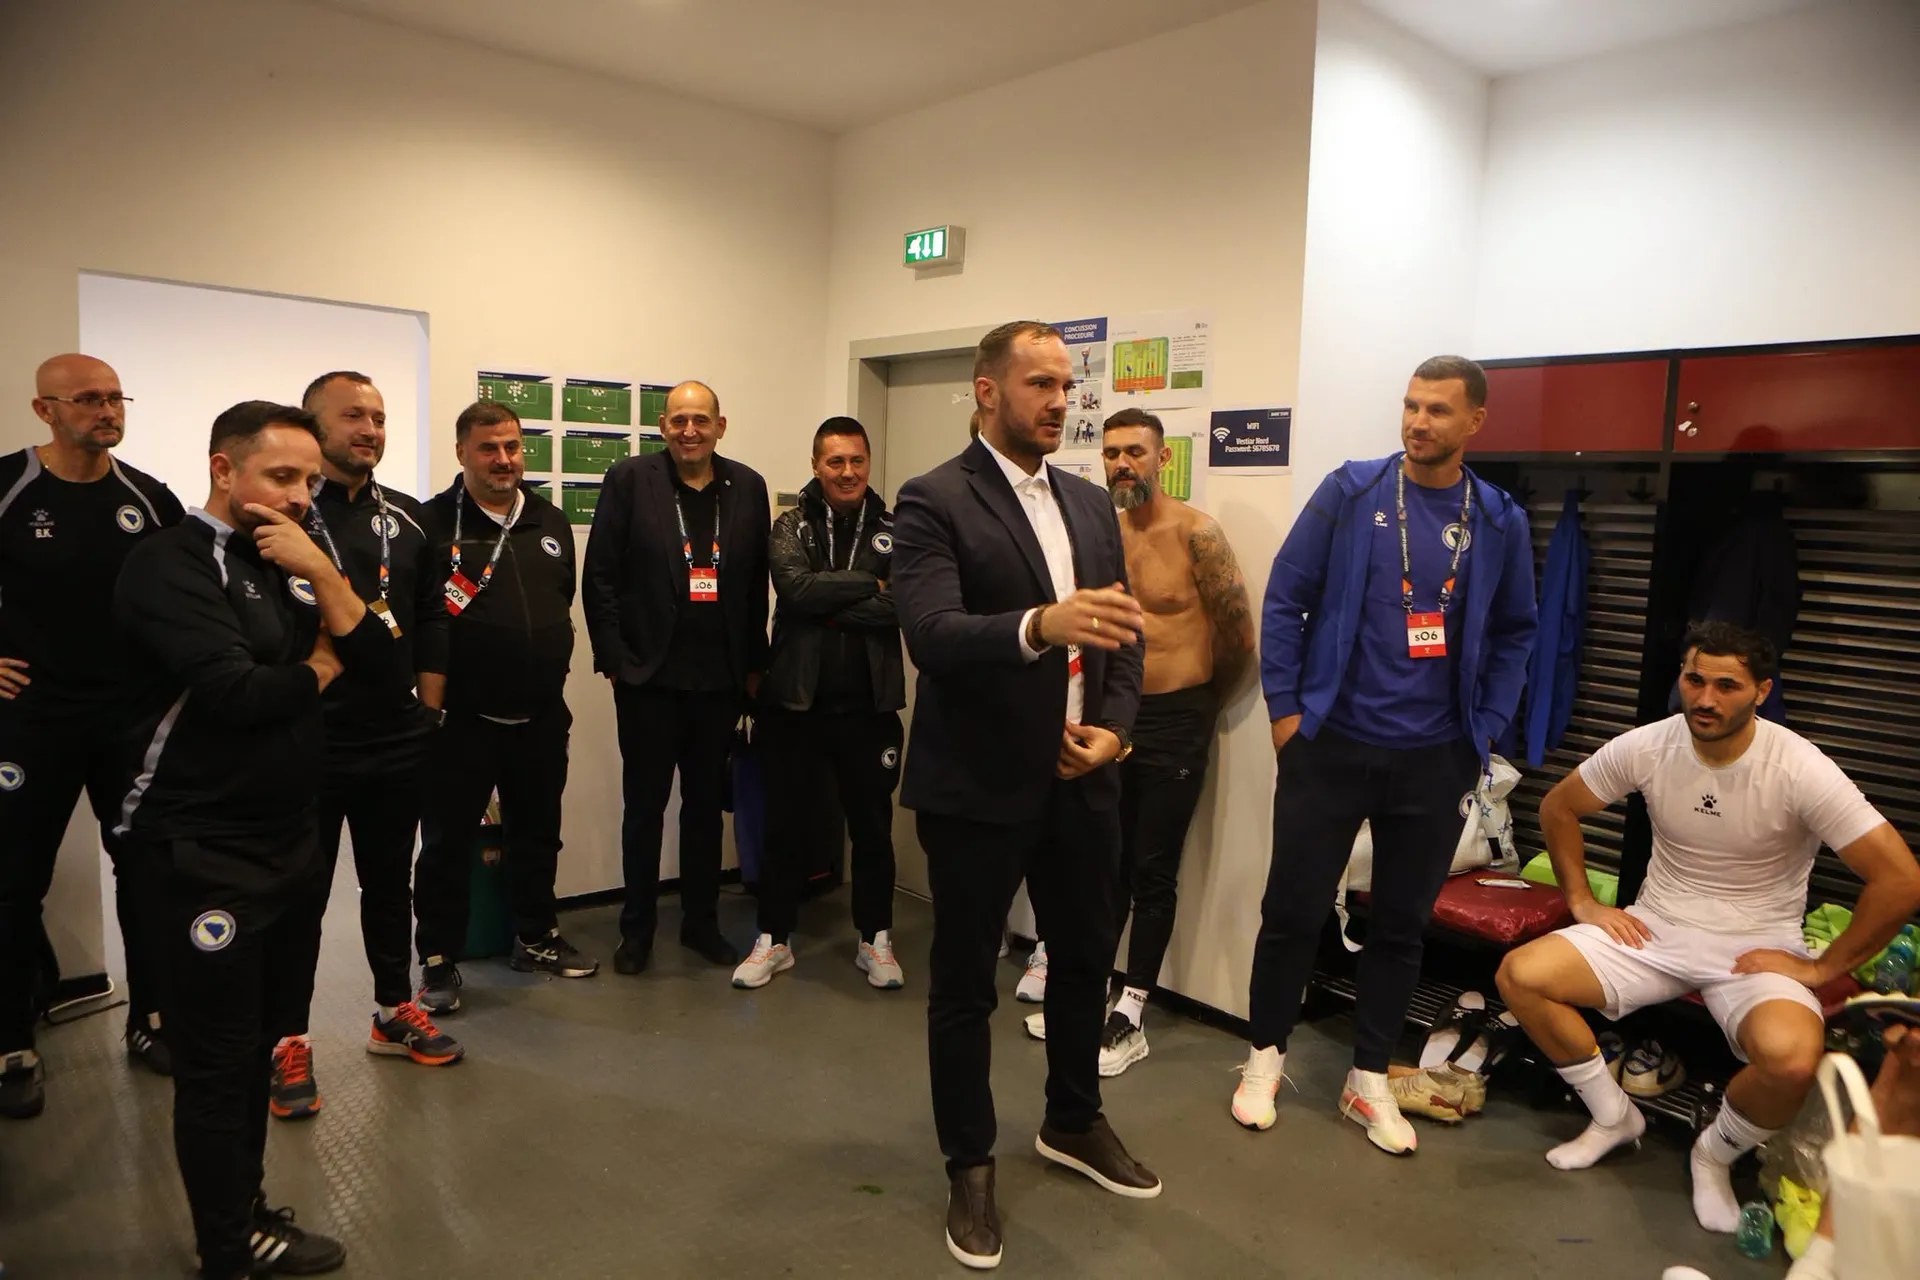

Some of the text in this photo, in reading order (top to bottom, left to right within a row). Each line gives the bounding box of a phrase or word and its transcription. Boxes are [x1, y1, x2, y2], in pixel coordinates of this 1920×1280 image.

[1064, 323, 1098, 333] CONCUSSION
[1064, 331, 1095, 340] PROCEDURE
[1255, 437, 1269, 445] Nord
[1694, 806, 1722, 818] KELME
